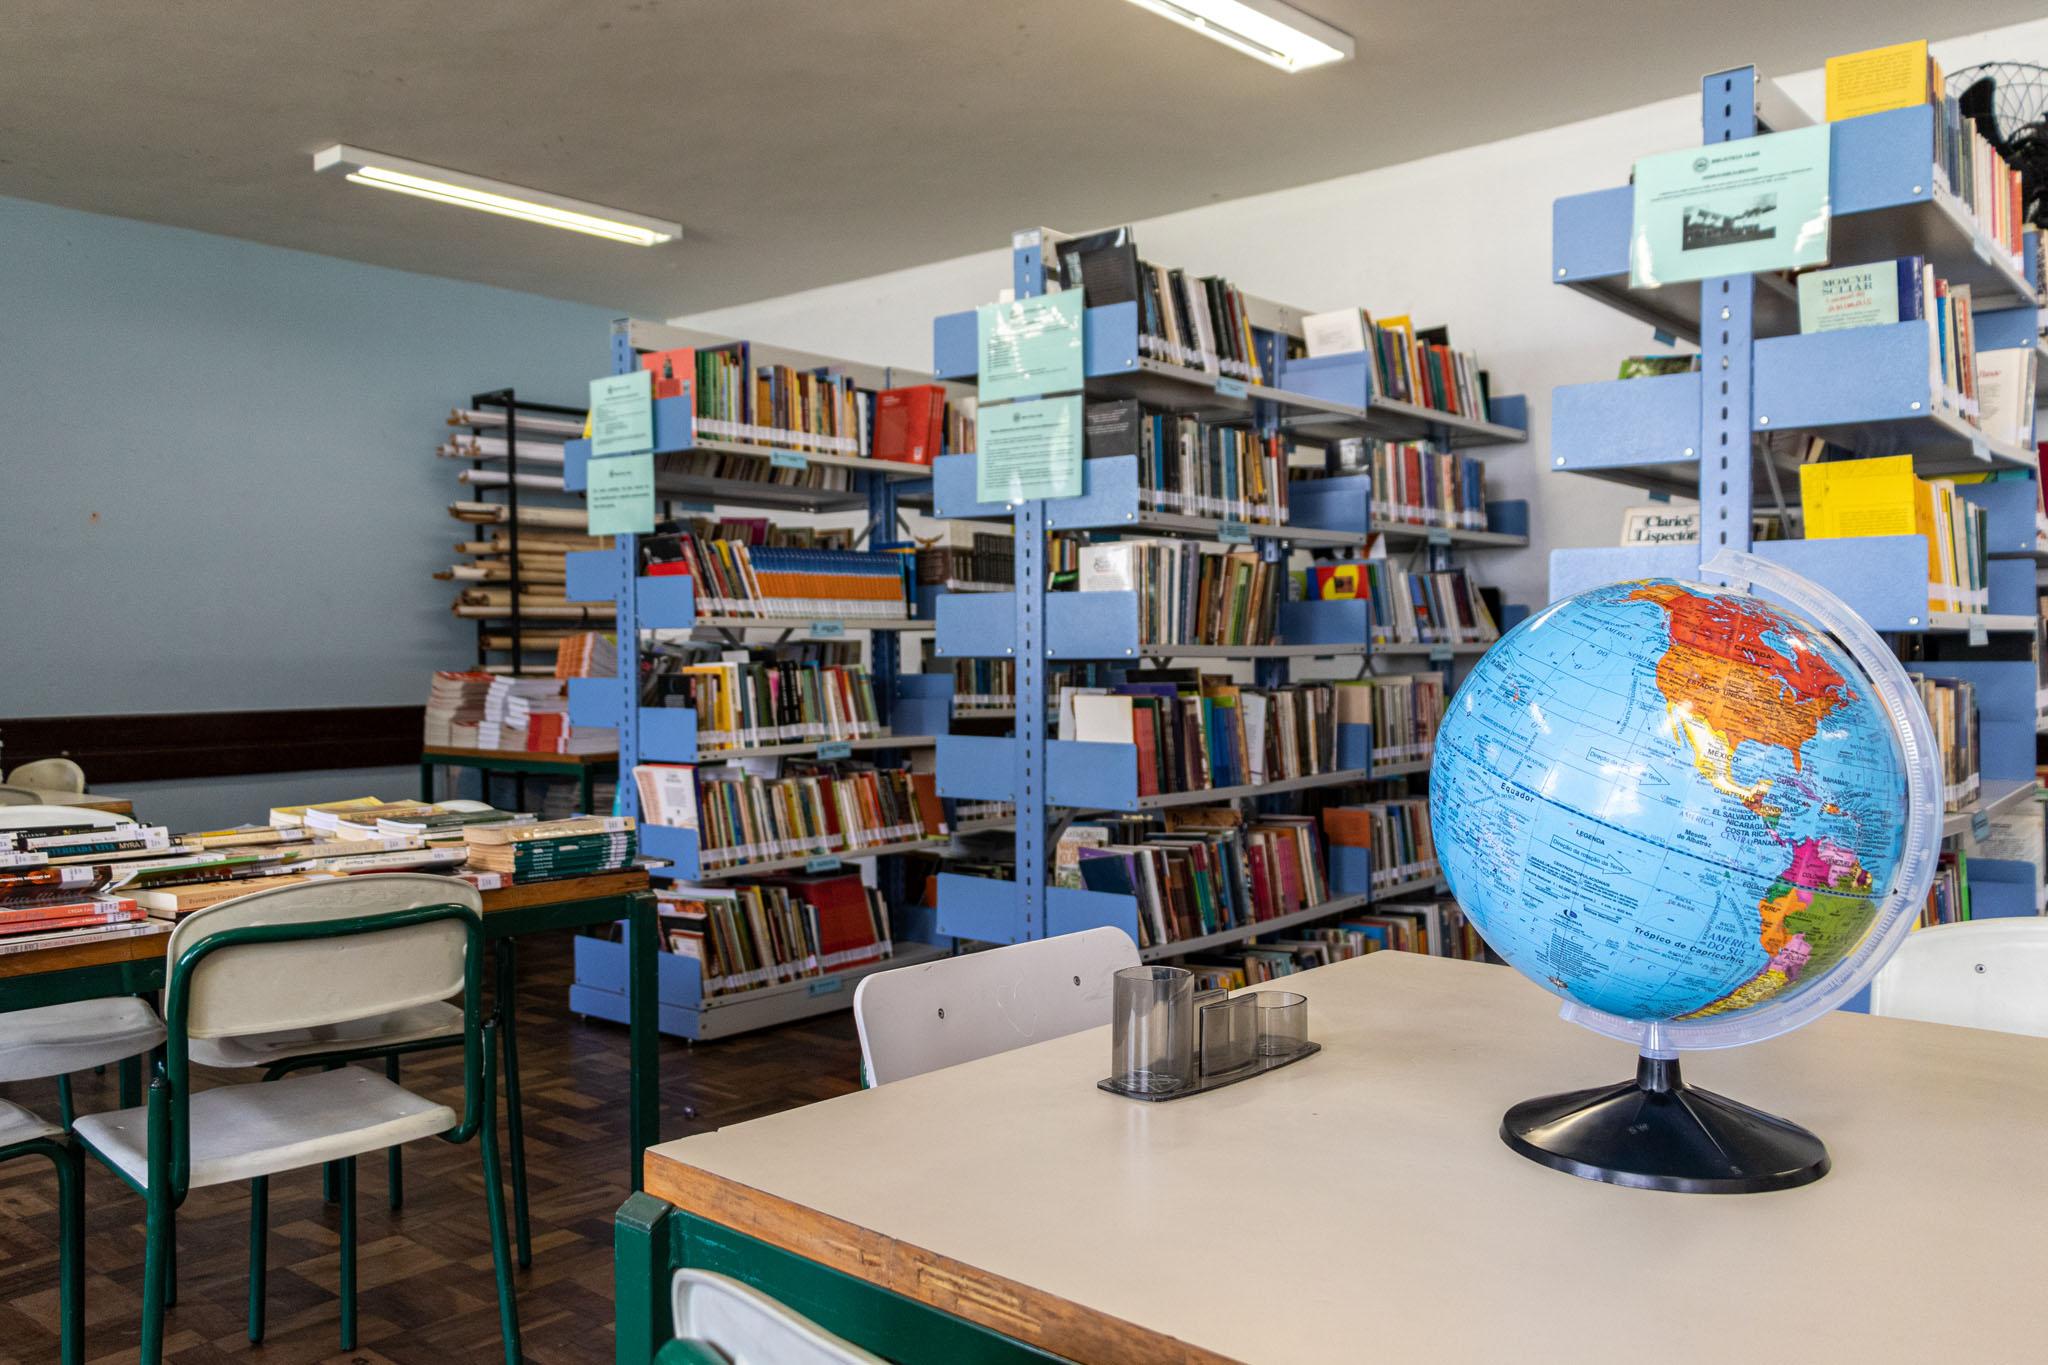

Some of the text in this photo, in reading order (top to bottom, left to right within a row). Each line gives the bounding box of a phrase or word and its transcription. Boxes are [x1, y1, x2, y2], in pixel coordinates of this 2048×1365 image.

[1823, 273, 1872, 287] MOACYR
[1823, 282, 1872, 296] SCLIAR
[1644, 514, 1694, 527] Clarice
[1635, 528, 1699, 543] Lispector
[1500, 782, 1535, 803] Equador
[1712, 808, 1761, 822] EL SALVADOR
[1575, 829, 1606, 846] LEGENDA
[1684, 829, 1708, 841] Meseta
[1724, 827, 1750, 838] COSTA
[119, 840, 141, 849] MYRA
[1553, 838, 1573, 853] Direção
[1610, 861, 1624, 872] Terra
[1634, 926, 1671, 945] Trópico
[1674, 941, 1687, 950] de
[1709, 932, 1756, 951] AMÉRICA
[1706, 942, 1725, 952] DO
